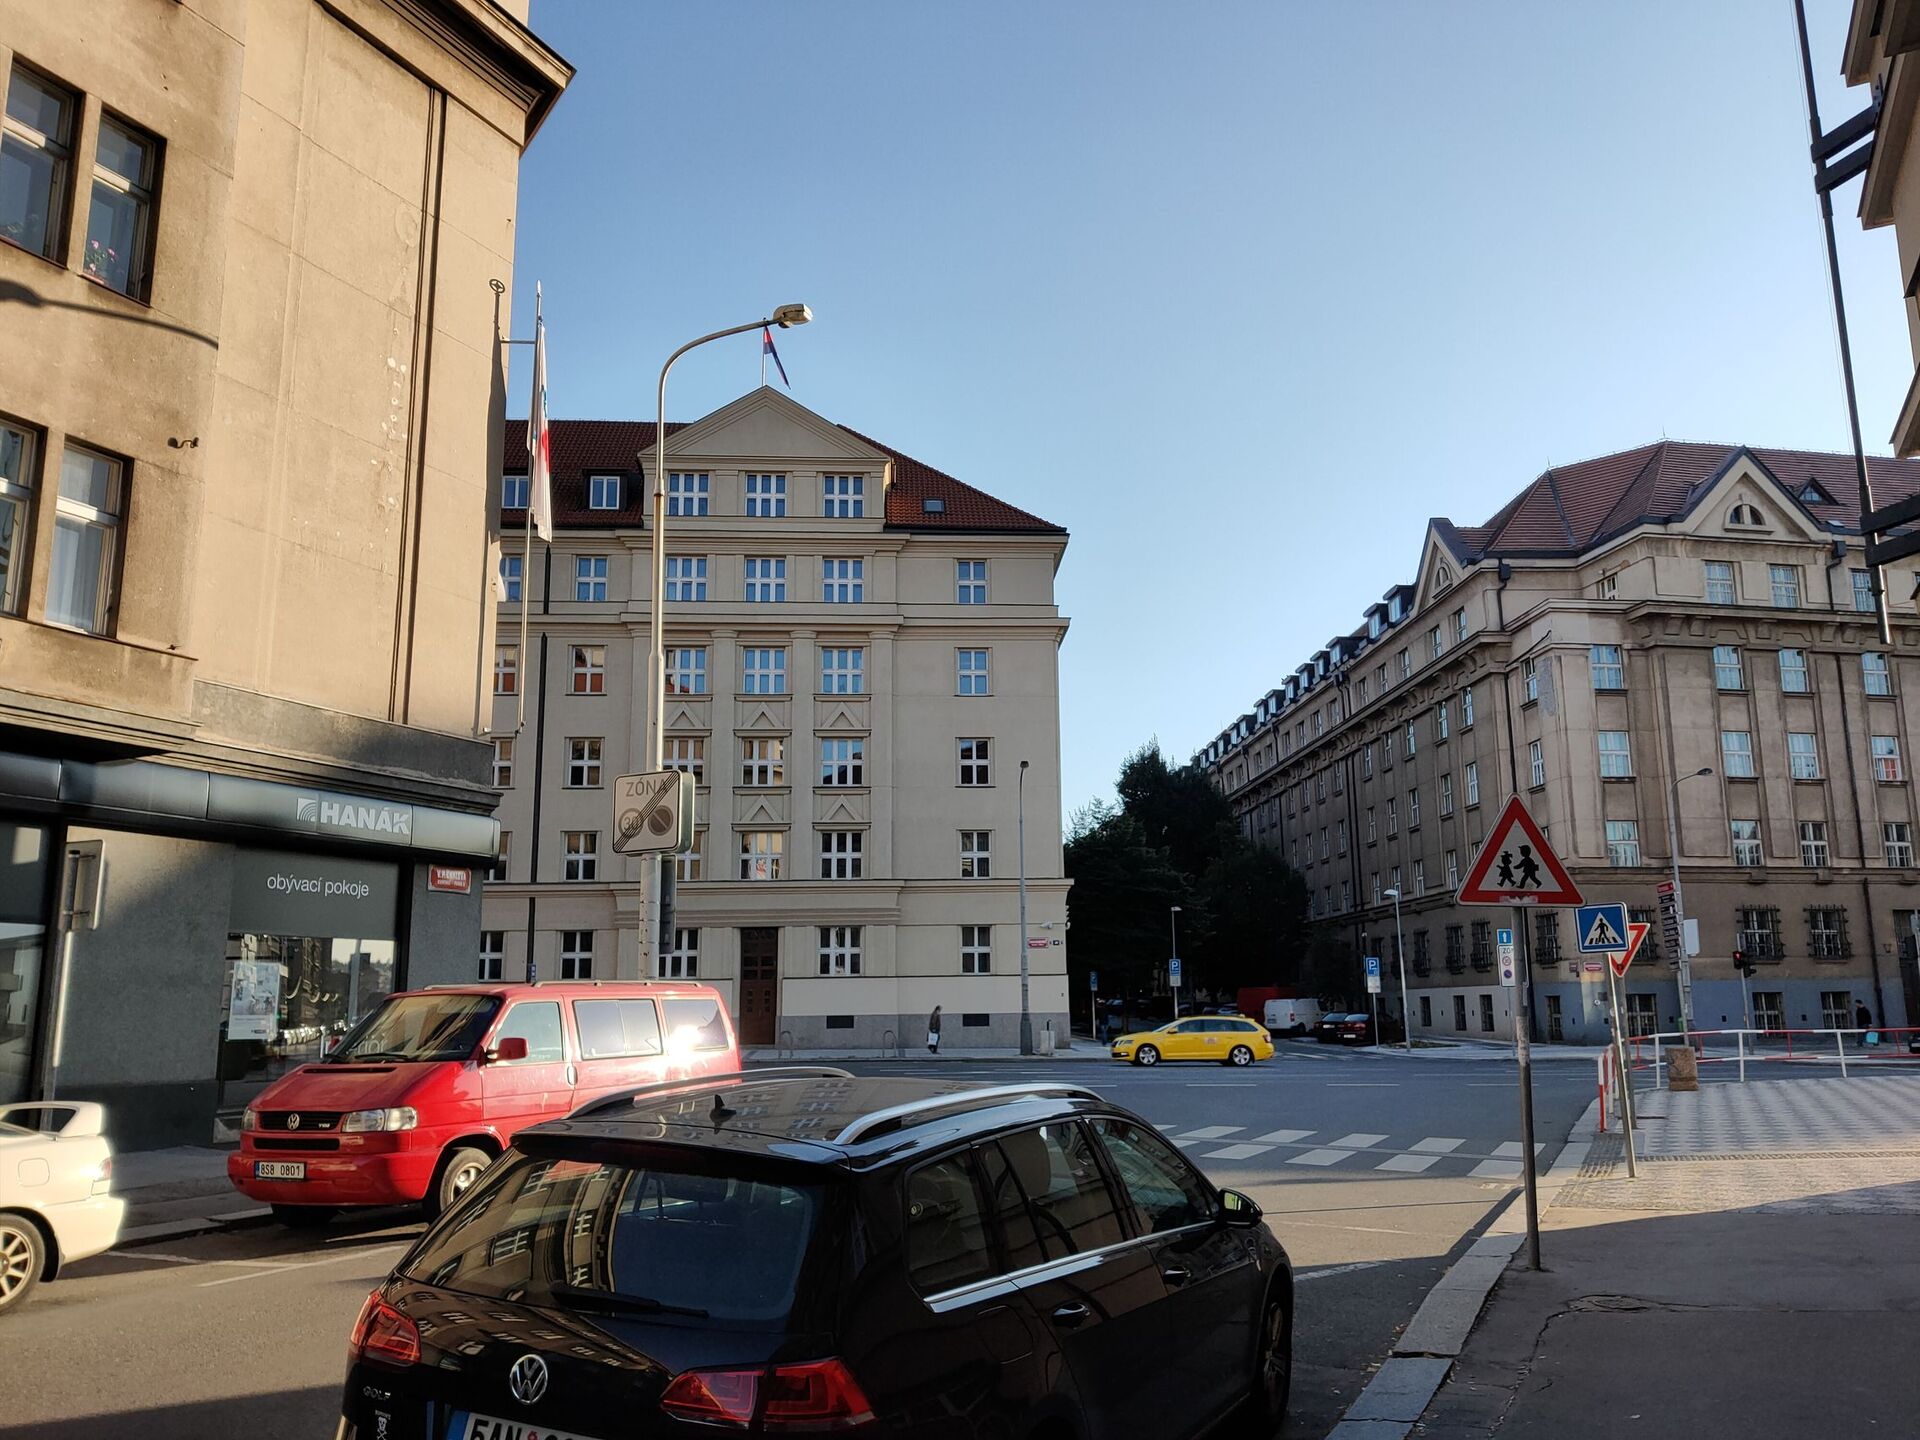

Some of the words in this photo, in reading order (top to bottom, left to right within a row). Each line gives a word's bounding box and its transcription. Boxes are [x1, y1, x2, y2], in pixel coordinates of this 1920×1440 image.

[319, 801, 410, 835] HANÁK
[267, 873, 322, 894] obývací
[324, 880, 369, 899] pokoje
[1368, 960, 1377, 970] P
[280, 1165, 301, 1177] 0801
